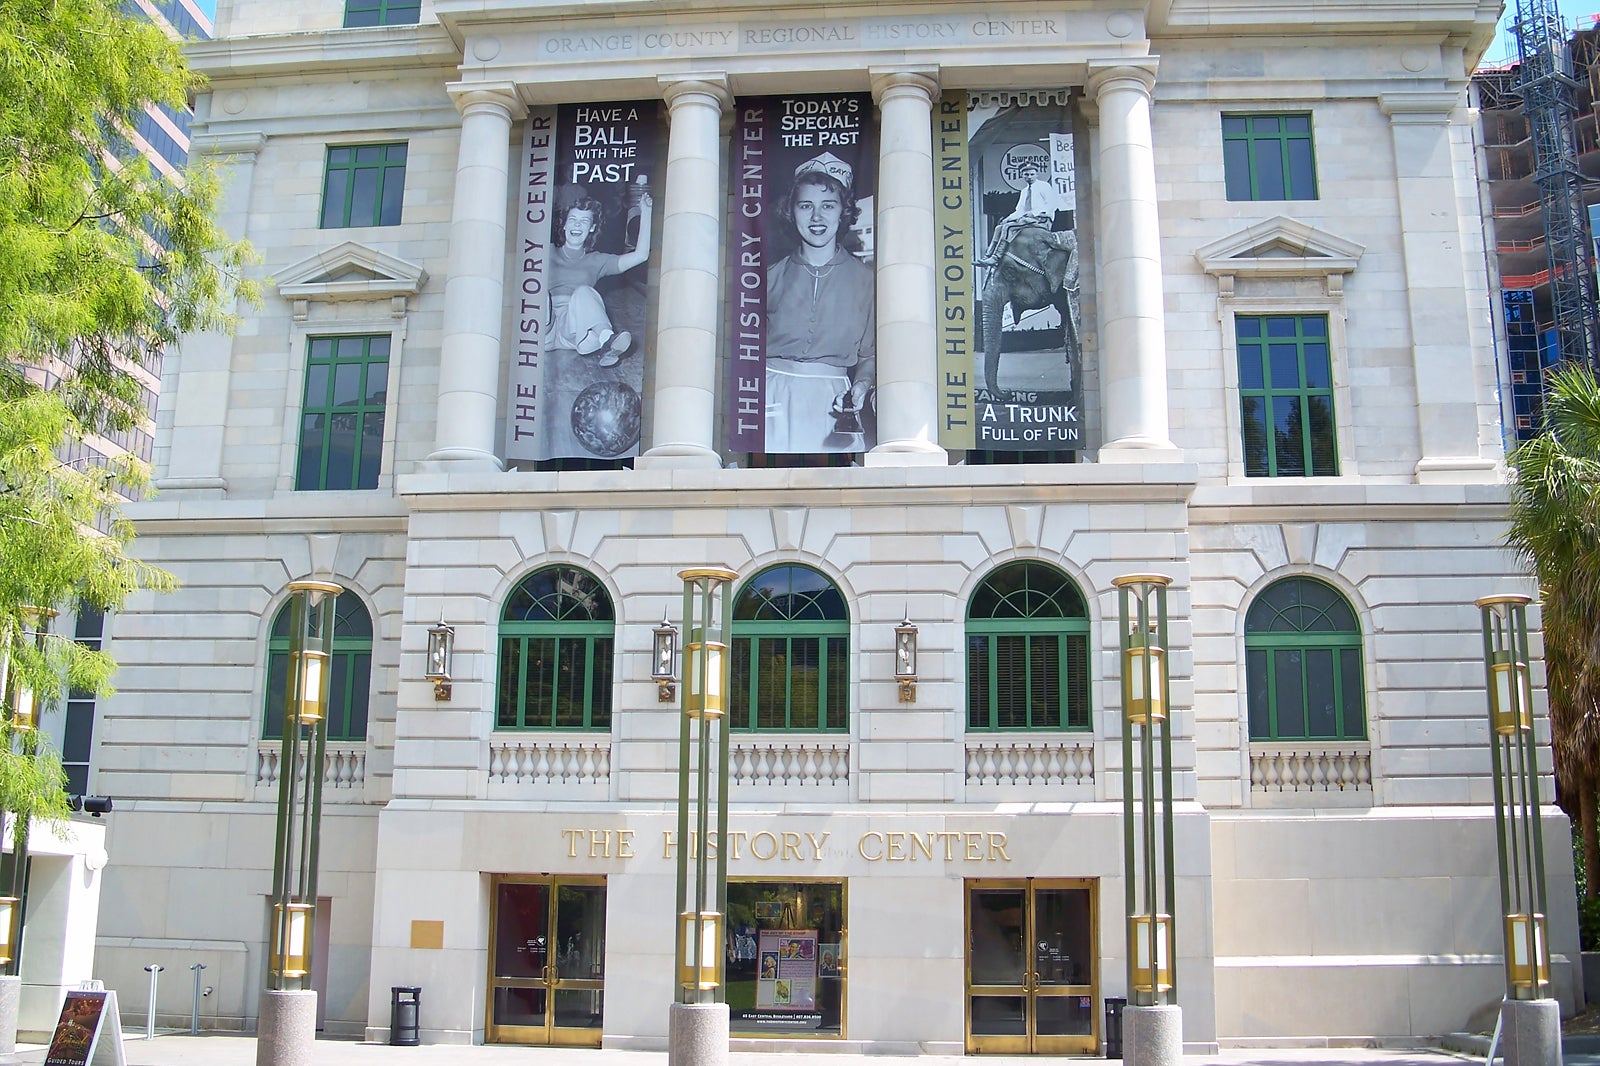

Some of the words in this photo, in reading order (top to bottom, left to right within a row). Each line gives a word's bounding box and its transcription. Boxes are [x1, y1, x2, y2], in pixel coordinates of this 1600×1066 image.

[545, 35, 633, 54] ORANGE
[644, 30, 733, 49] COUNTY
[745, 25, 855, 44] REGIONAL
[867, 22, 960, 39] HISTORY
[972, 20, 1059, 36] CENTER
[576, 108, 622, 123] HAVE
[627, 108, 638, 121] A
[782, 98, 859, 115] TODAY'S
[574, 125, 637, 146] BALL
[781, 115, 860, 131] SPECIAL:
[782, 134, 813, 147] THE
[818, 131, 860, 146] PAST
[527, 115, 551, 223] CENTER
[574, 148, 607, 160] WITH
[611, 147, 637, 158] THE
[742, 109, 763, 218] CENTER
[940, 101, 963, 210] CENTER
[1006, 152, 1050, 167] Lawrence
[572, 162, 635, 184] PAST
[517, 238, 544, 368] HISTORY
[740, 231, 761, 362] HISTORY
[944, 226, 966, 355] HISTORY
[514, 383, 537, 441] THE
[737, 377, 759, 435] THE
[946, 372, 967, 430] THE
[982, 404, 997, 422] A
[1005, 404, 1077, 422] TRUNK
[982, 426, 1019, 440] FULL
[1023, 429, 1043, 441] OF
[1047, 427, 1078, 440] FUN
[561, 829, 636, 858] THE
[858, 831, 1011, 861] CENTER
